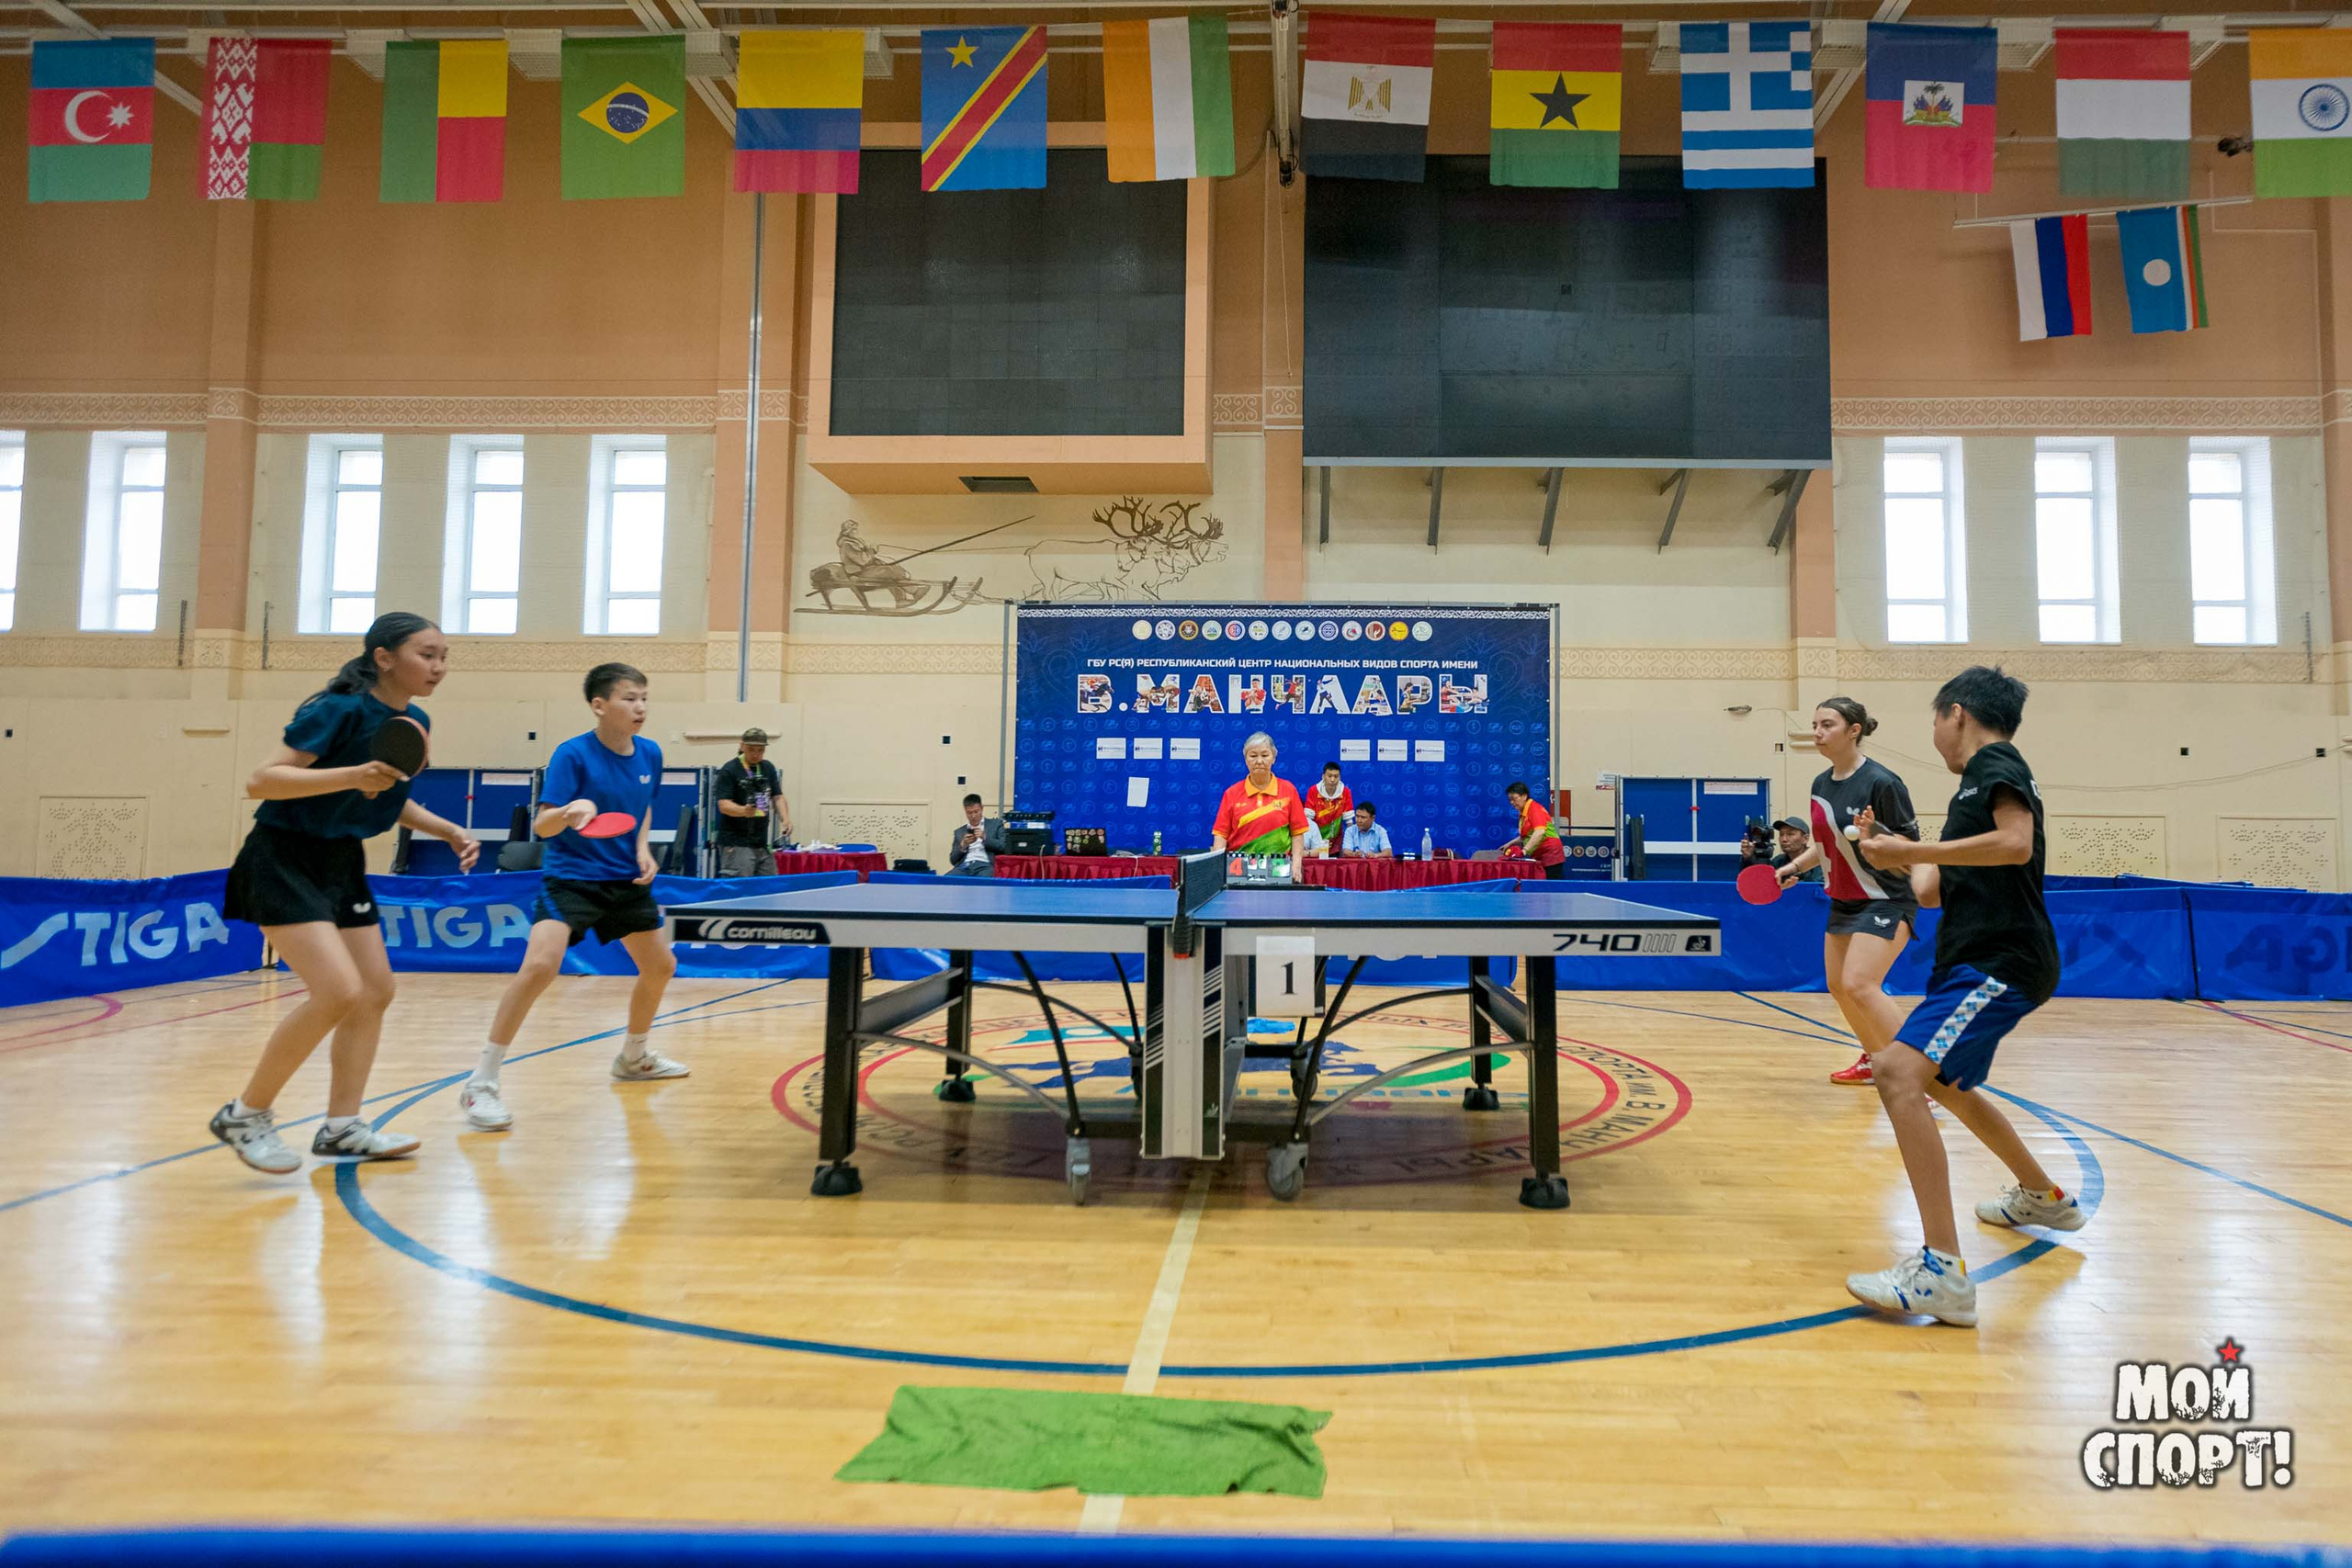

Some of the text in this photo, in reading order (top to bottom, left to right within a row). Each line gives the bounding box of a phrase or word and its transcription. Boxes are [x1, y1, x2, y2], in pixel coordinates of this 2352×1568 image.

[1087, 657, 1478, 670] ГБУ РС(Я) РЕСПУБЛИКАНСКИЙ ЦЕНТР НАЦИОНАЛЬНЫХ ВИДОВ СПОРТА ИМЕНИ
[1077, 673, 1489, 716] В.МАНЧААРЫ
[1, 902, 230, 970] STIGA
[378, 903, 532, 949] TIGA
[727, 925, 817, 941] cornilleau
[1553, 933, 1642, 952] 740
[1281, 961, 1298, 996] 1
